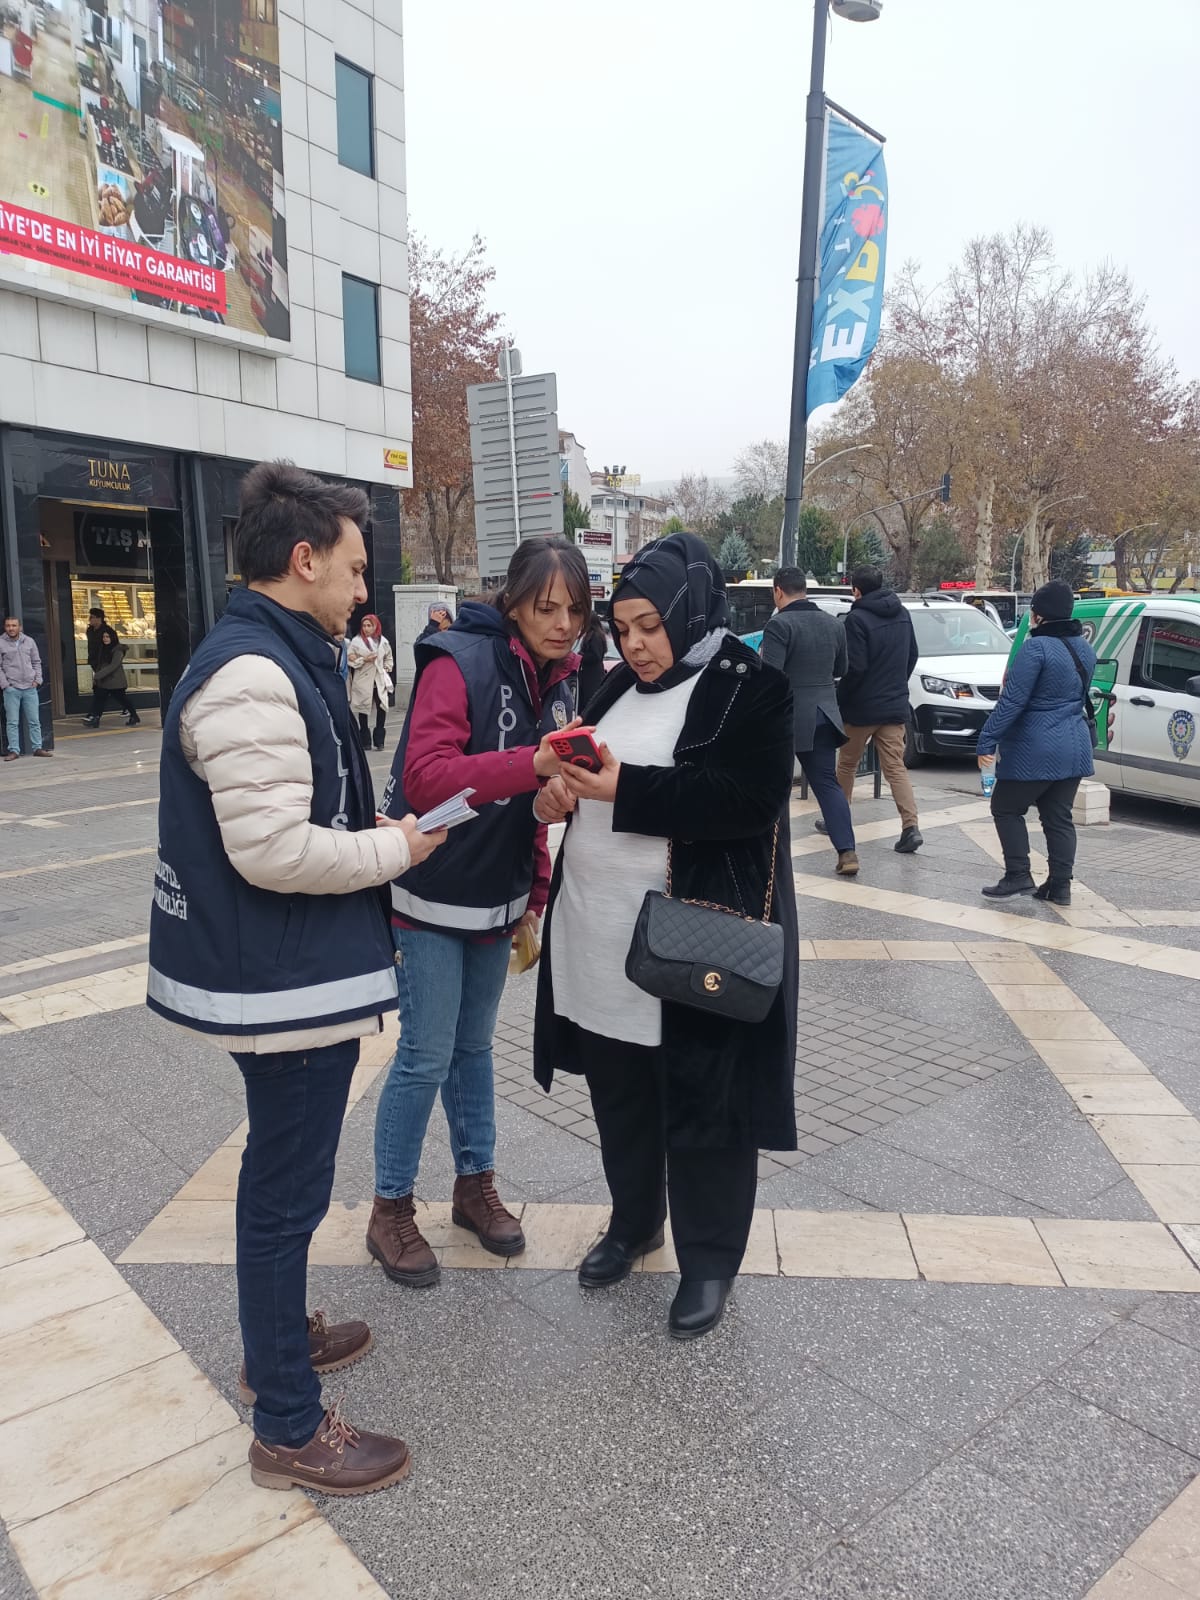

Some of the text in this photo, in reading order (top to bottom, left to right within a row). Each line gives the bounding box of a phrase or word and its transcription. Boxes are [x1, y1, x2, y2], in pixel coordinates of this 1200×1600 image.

[56, 227, 77, 252] EN
[80, 229, 100, 259] İYİ
[103, 240, 142, 271] FİYAT
[145, 255, 217, 294] GARANTİSİ
[87, 458, 131, 481] TUNA
[88, 478, 132, 492] KUYUMCULUK
[92, 527, 133, 553] TAŞ
